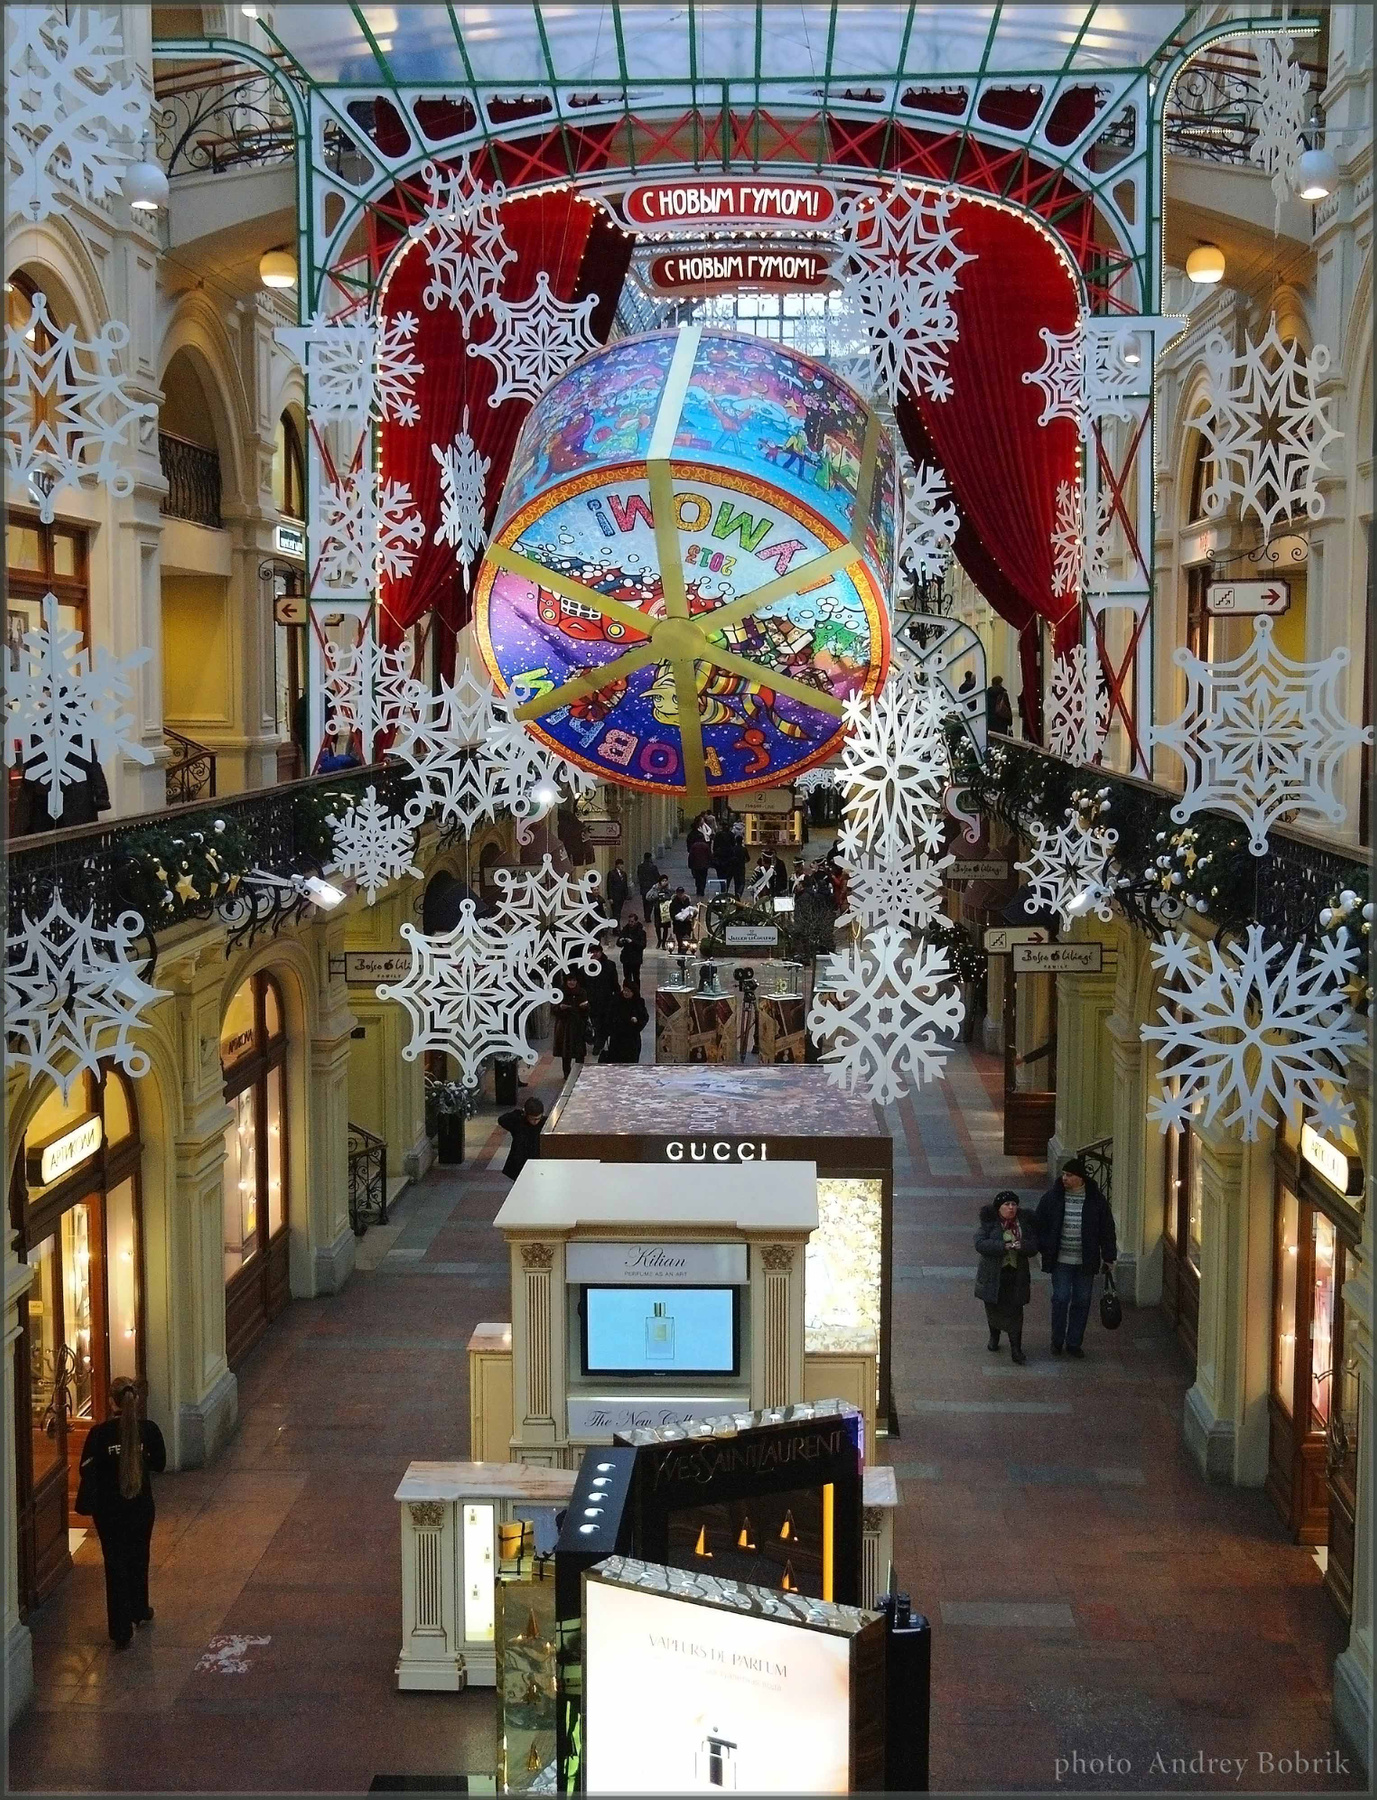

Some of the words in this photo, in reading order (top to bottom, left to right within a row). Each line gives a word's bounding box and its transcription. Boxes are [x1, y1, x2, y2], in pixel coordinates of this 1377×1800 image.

[642, 192, 655, 217] С
[658, 187, 735, 216] НОВЫМ
[739, 187, 819, 216] ГУМОМ!
[664, 259, 675, 281] С
[678, 256, 743, 280] НОВЫМ
[747, 255, 816, 280] ГУМОМ!
[684, 544, 737, 577] 2013
[665, 1141, 767, 1161] GUCCI
[624, 1246, 687, 1268] Kilian
[584, 1410, 612, 1427] The
[616, 1409, 652, 1427] New
